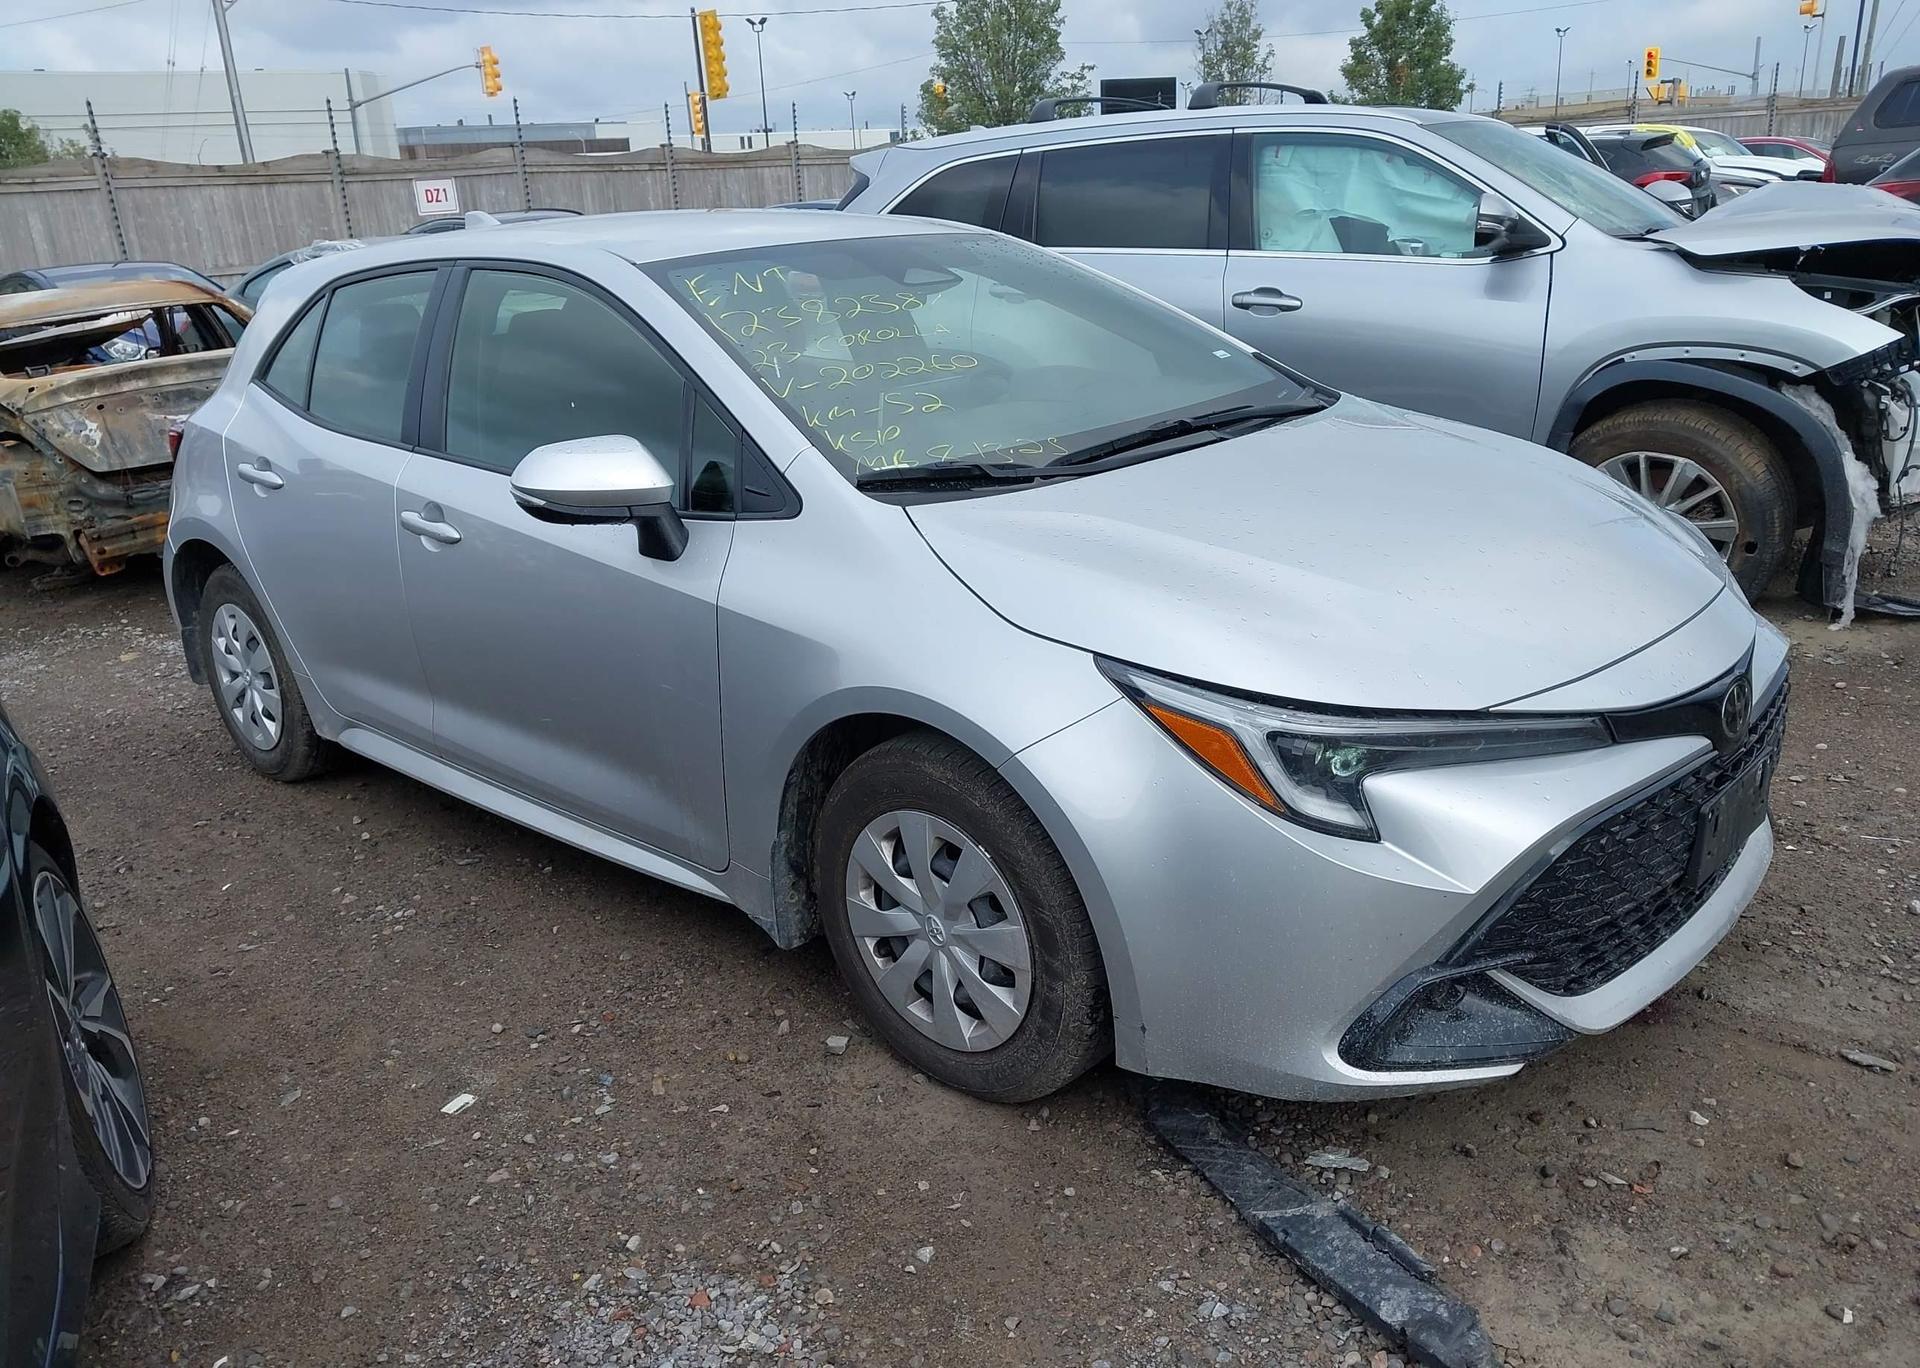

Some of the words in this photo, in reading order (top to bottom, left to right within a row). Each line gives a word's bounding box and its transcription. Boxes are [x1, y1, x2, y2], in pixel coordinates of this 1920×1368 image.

[424, 187, 449, 204] DZ1
[684, 265, 788, 306] ENT
[816, 322, 951, 351] COROLLA
